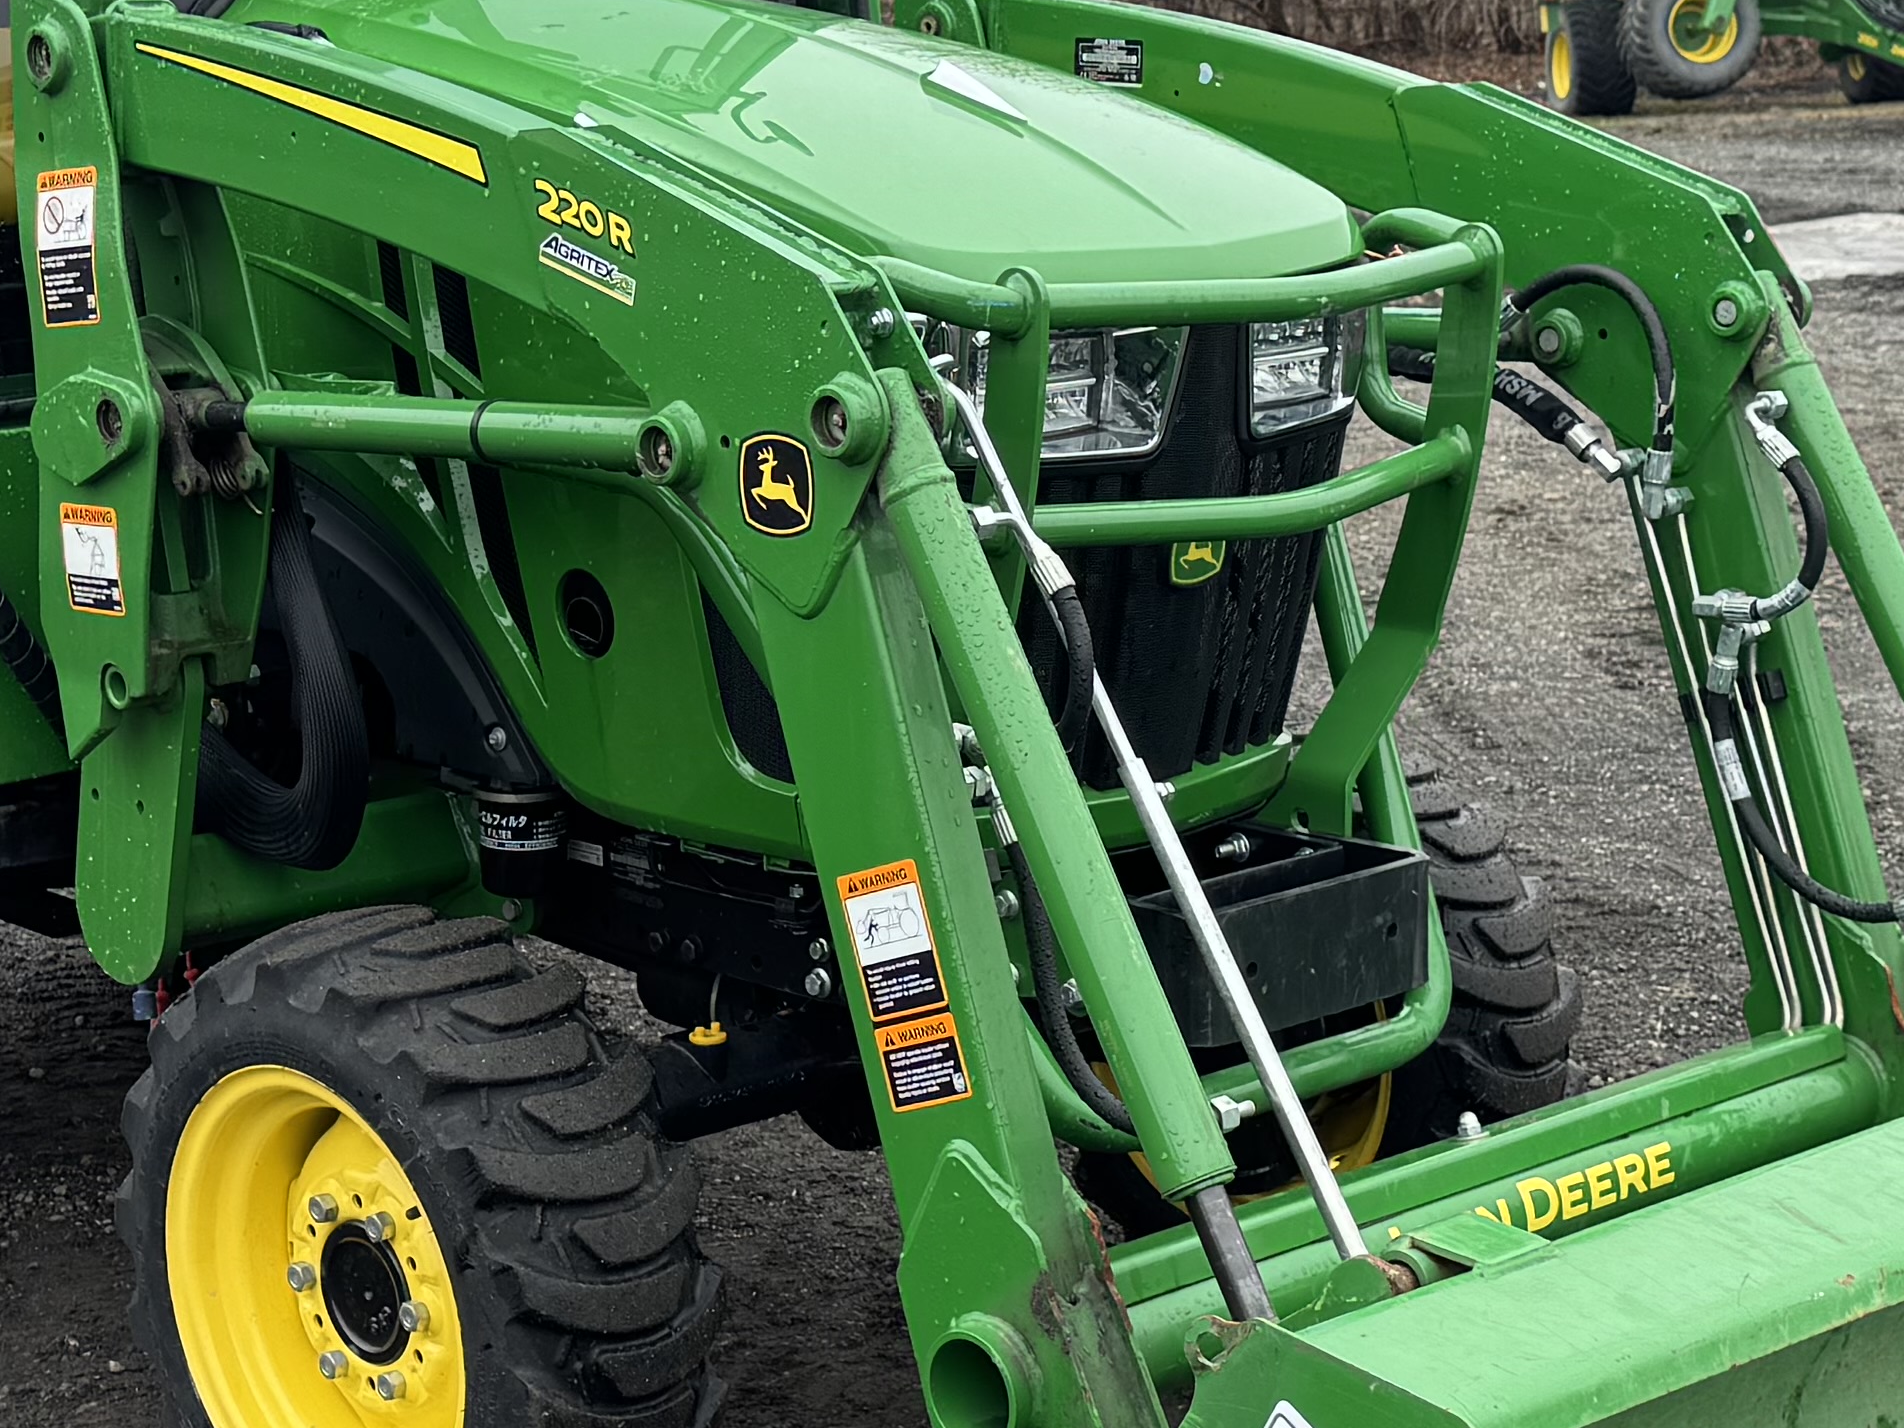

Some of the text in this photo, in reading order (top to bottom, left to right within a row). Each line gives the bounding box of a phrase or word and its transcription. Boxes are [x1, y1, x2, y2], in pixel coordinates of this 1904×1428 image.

[47, 170, 94, 188] WARNING
[542, 235, 616, 283] AGRITEX
[1494, 369, 1544, 407] MSH
[71, 506, 114, 523] WARNING
[859, 868, 908, 890] WARNING
[897, 1021, 947, 1043] WARNING
[1516, 1141, 1676, 1233] DEERE
